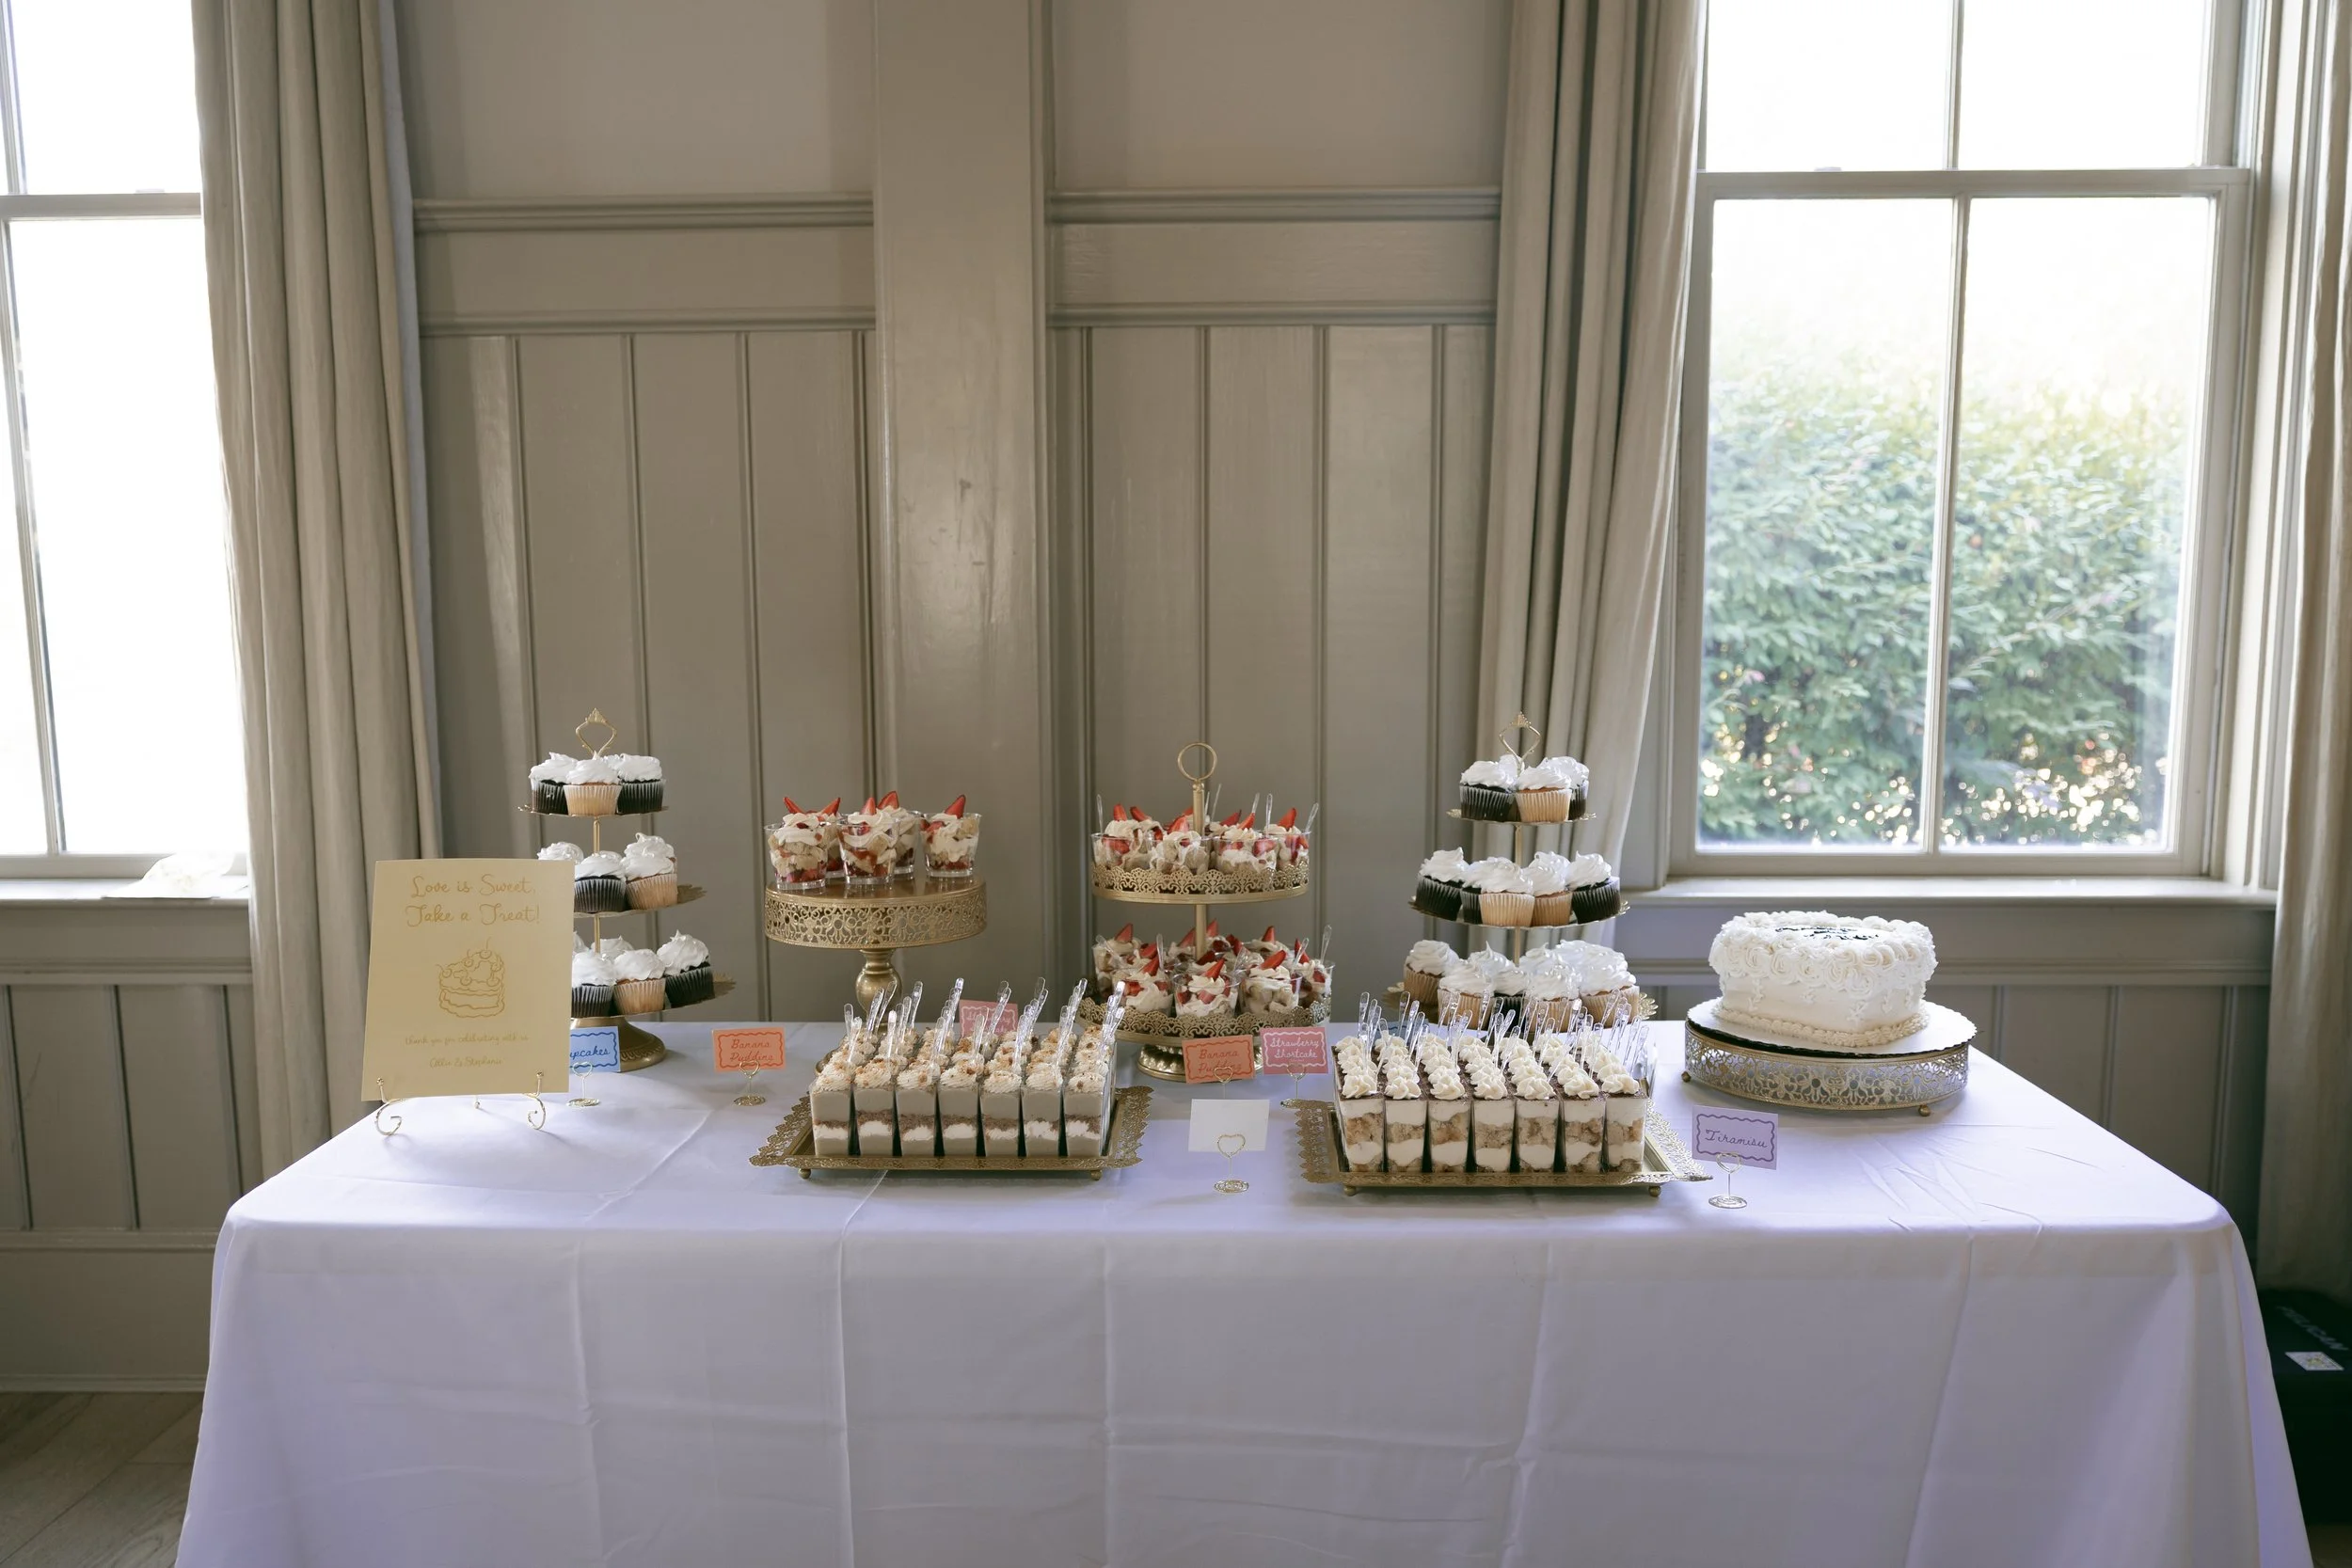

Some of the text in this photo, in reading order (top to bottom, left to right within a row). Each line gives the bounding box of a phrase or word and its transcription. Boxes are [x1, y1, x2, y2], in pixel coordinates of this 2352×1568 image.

[410, 875, 451, 898] Love
[456, 880, 472, 893] is
[405, 903, 540, 927] Take a Treat!
[731, 1038, 771, 1049] Banana
[1270, 1037, 1320, 1050] Strawberry
[570, 1045, 611, 1060] upcakes
[730, 1051, 774, 1062] Pudding
[1199, 1048, 1240, 1059] Banana
[1274, 1048, 1318, 1058] Shortcake
[1705, 1129, 1768, 1148] Tiramisu
